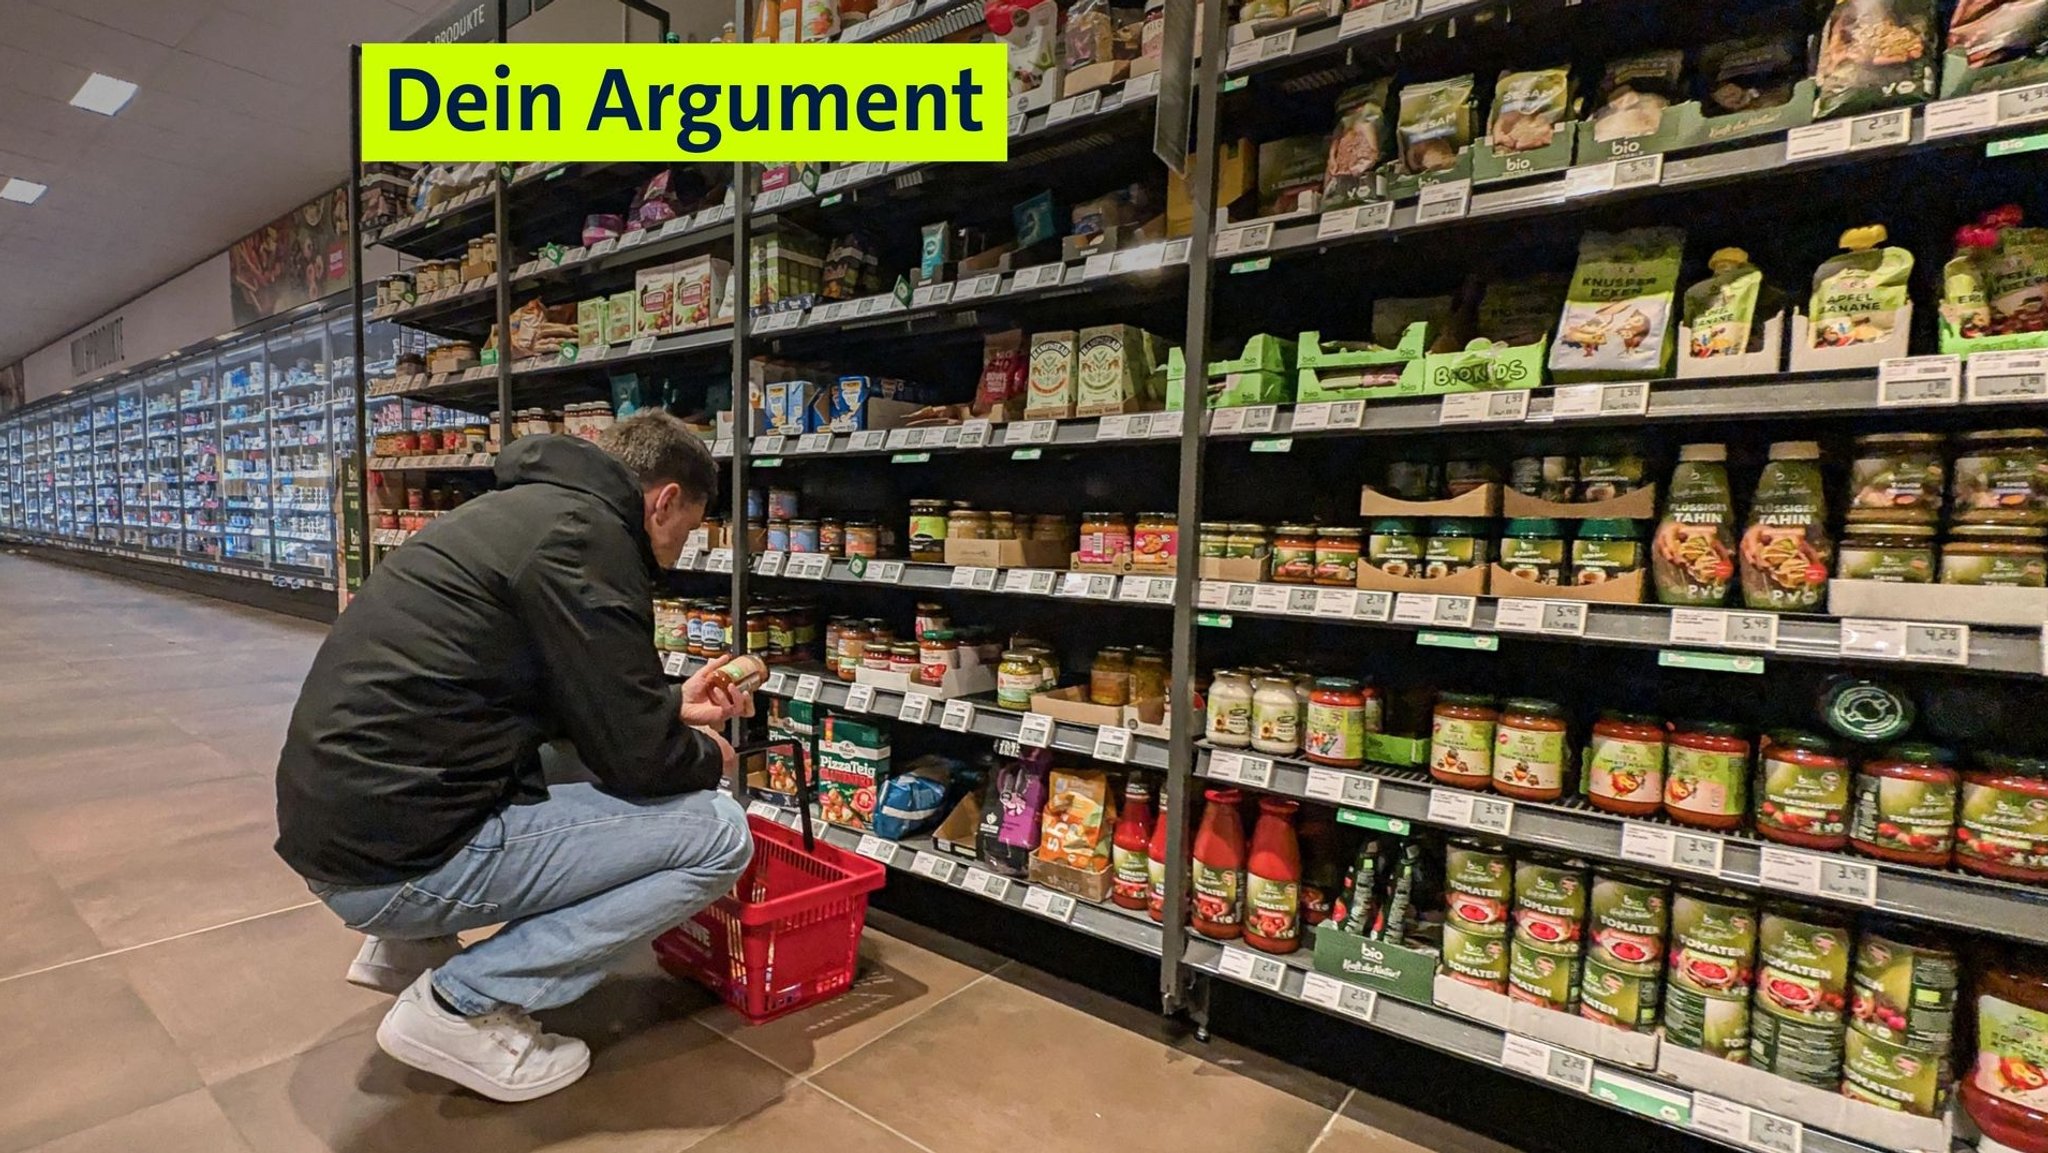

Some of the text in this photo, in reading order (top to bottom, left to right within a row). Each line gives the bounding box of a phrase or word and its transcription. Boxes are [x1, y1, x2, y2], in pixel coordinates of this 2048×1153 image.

[1612, 140, 1641, 156] bio
[1505, 158, 1532, 172] bio
[1582, 276, 1657, 288] KNUSPER
[1590, 287, 1645, 299] ECKEN
[1827, 293, 1874, 304] APFEL
[1673, 512, 1723, 523] TAHIN
[1758, 514, 1812, 525] TAHIN
[1449, 880, 1502, 898] TOMATEN
[1519, 896, 1575, 917] TOMATEN
[1361, 942, 1384, 961] bio
[1679, 934, 1746, 957] TOMATEN
[1448, 960, 1501, 979] TOMATEN
